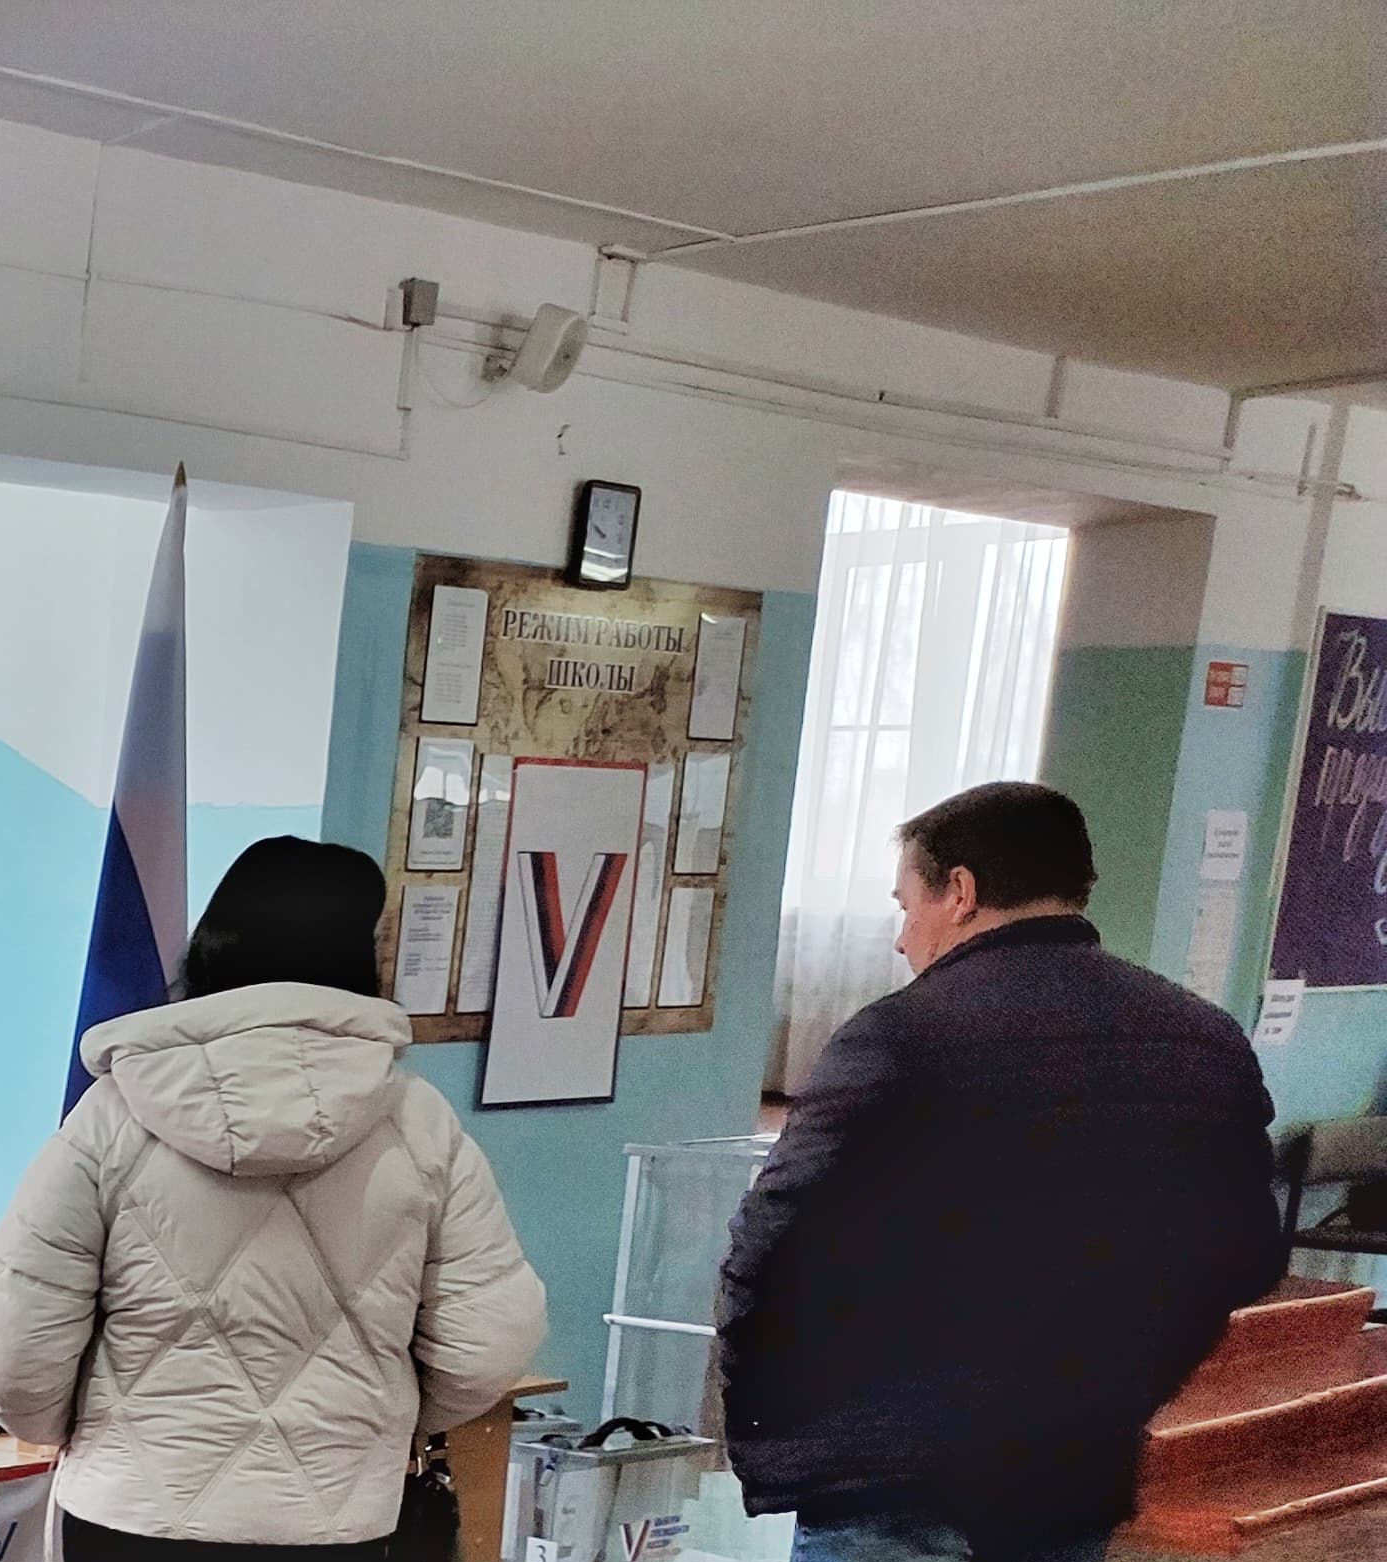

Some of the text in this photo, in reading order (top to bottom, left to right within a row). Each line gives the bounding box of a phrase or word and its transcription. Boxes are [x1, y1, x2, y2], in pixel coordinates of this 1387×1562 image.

[502, 610, 589, 644] РЕЖИМ
[595, 619, 685, 653] РАБОТЫ
[547, 659, 636, 692] ШКОЛЫ
